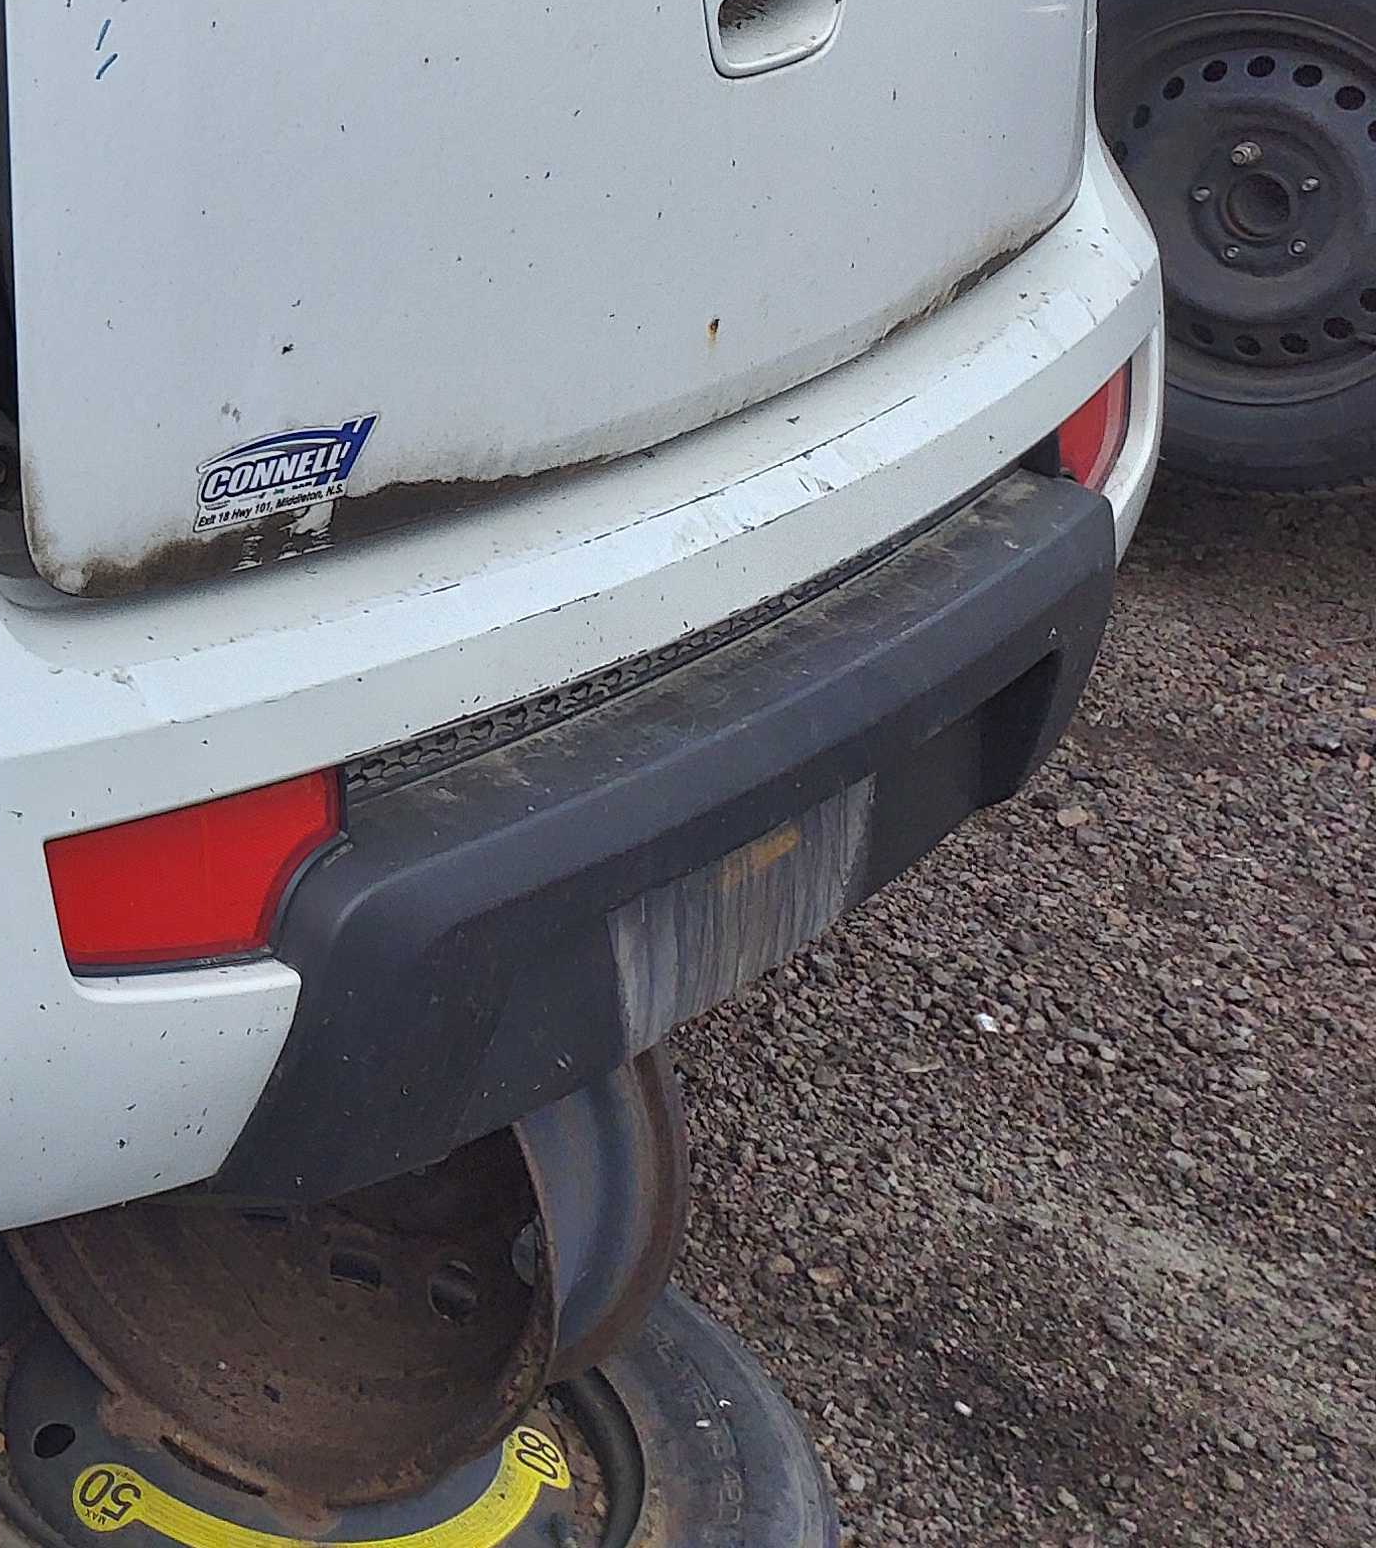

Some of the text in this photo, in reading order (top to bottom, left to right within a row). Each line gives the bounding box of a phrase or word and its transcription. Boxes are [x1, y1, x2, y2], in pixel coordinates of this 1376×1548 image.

[231, 506, 252, 521] Hwy
[516, 1431, 560, 1479] 80
[79, 1470, 141, 1521] 50
